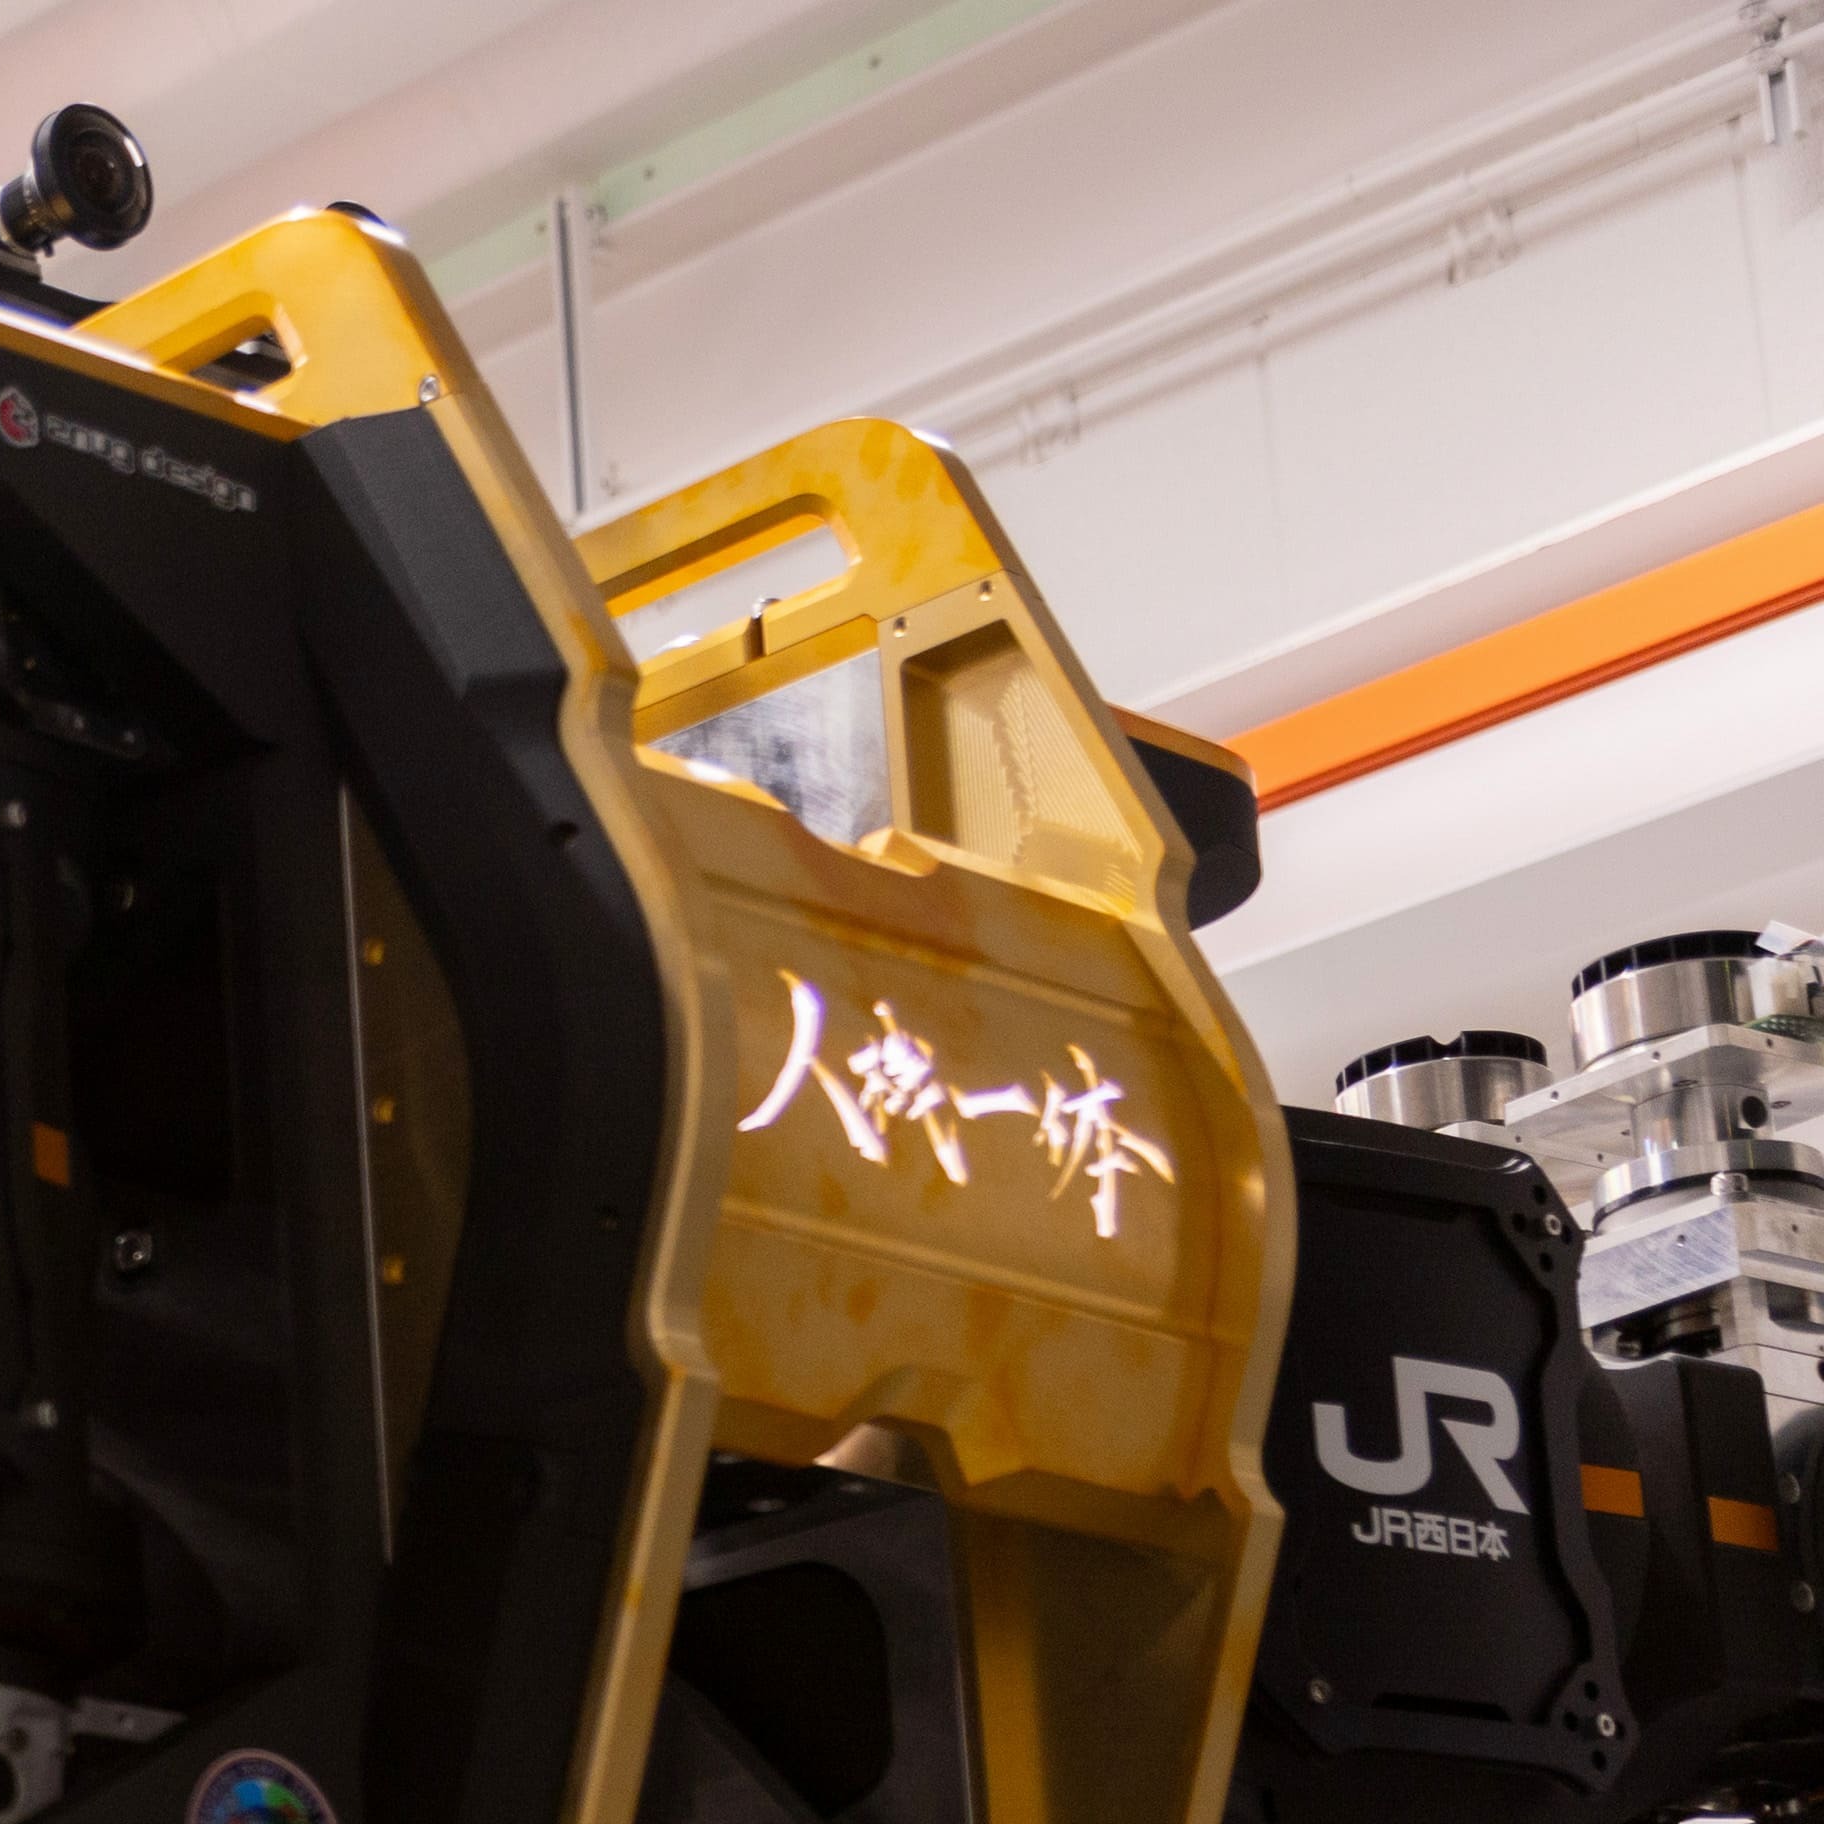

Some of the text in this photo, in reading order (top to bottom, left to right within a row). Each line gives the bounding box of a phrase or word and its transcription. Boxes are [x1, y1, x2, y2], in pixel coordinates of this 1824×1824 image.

[1311, 1355, 1532, 1517] JR
[1352, 1505, 1512, 1563] JR西日本
